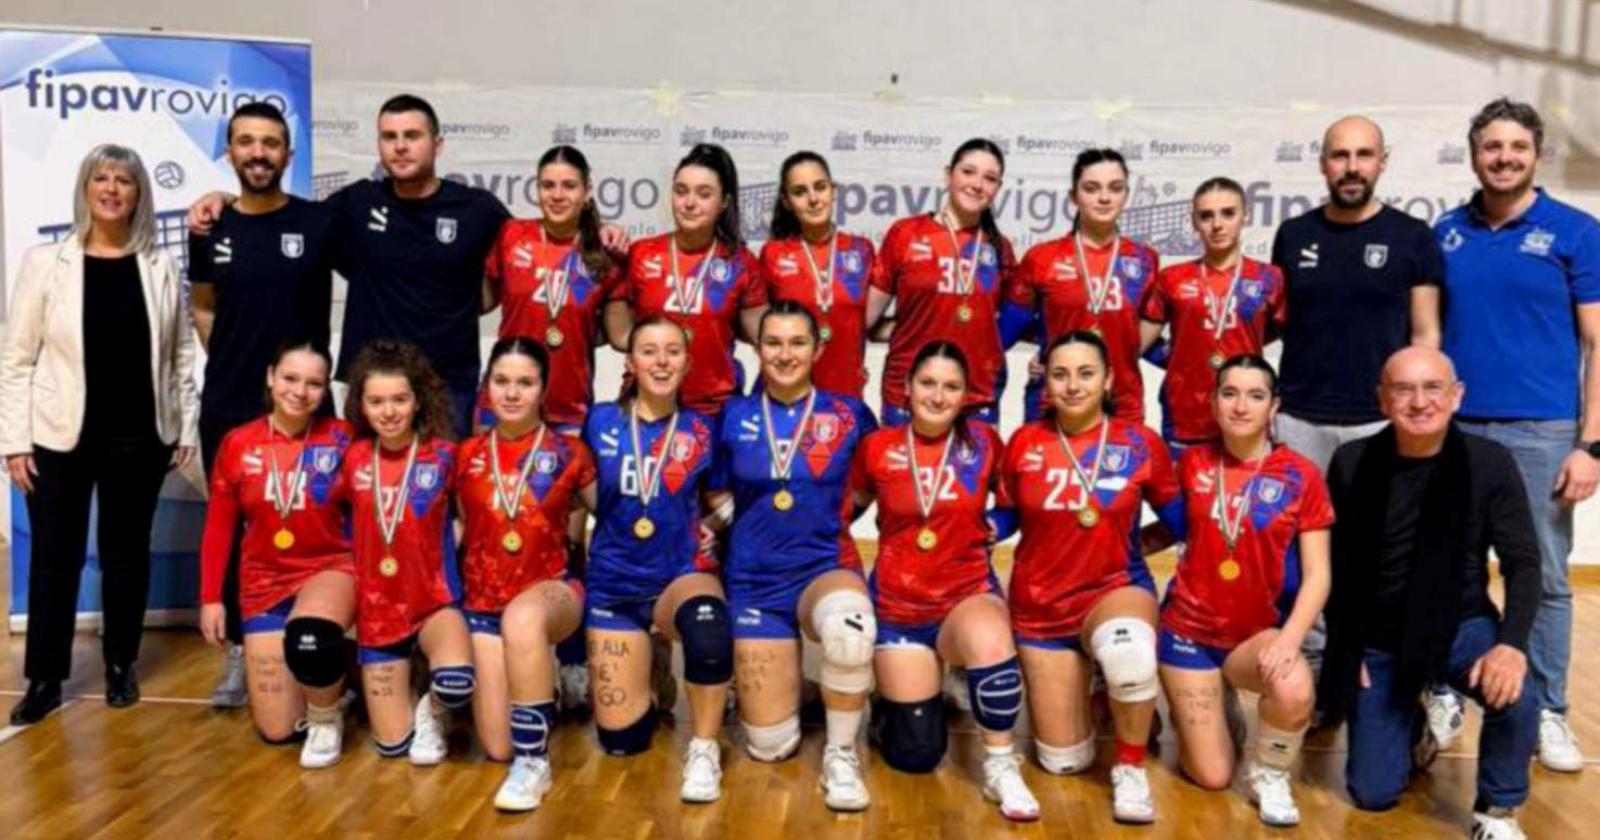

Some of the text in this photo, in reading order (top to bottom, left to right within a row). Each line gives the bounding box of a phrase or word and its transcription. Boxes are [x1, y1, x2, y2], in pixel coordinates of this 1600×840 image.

[441, 122, 510, 140] pavrovigo
[583, 122, 661, 141] fipavrovigo
[712, 126, 789, 144] fipavrovigo
[863, 130, 942, 150] fipavrovigo
[1149, 139, 1232, 157] fipavrovigo
[1043, 468, 1091, 510] 25
